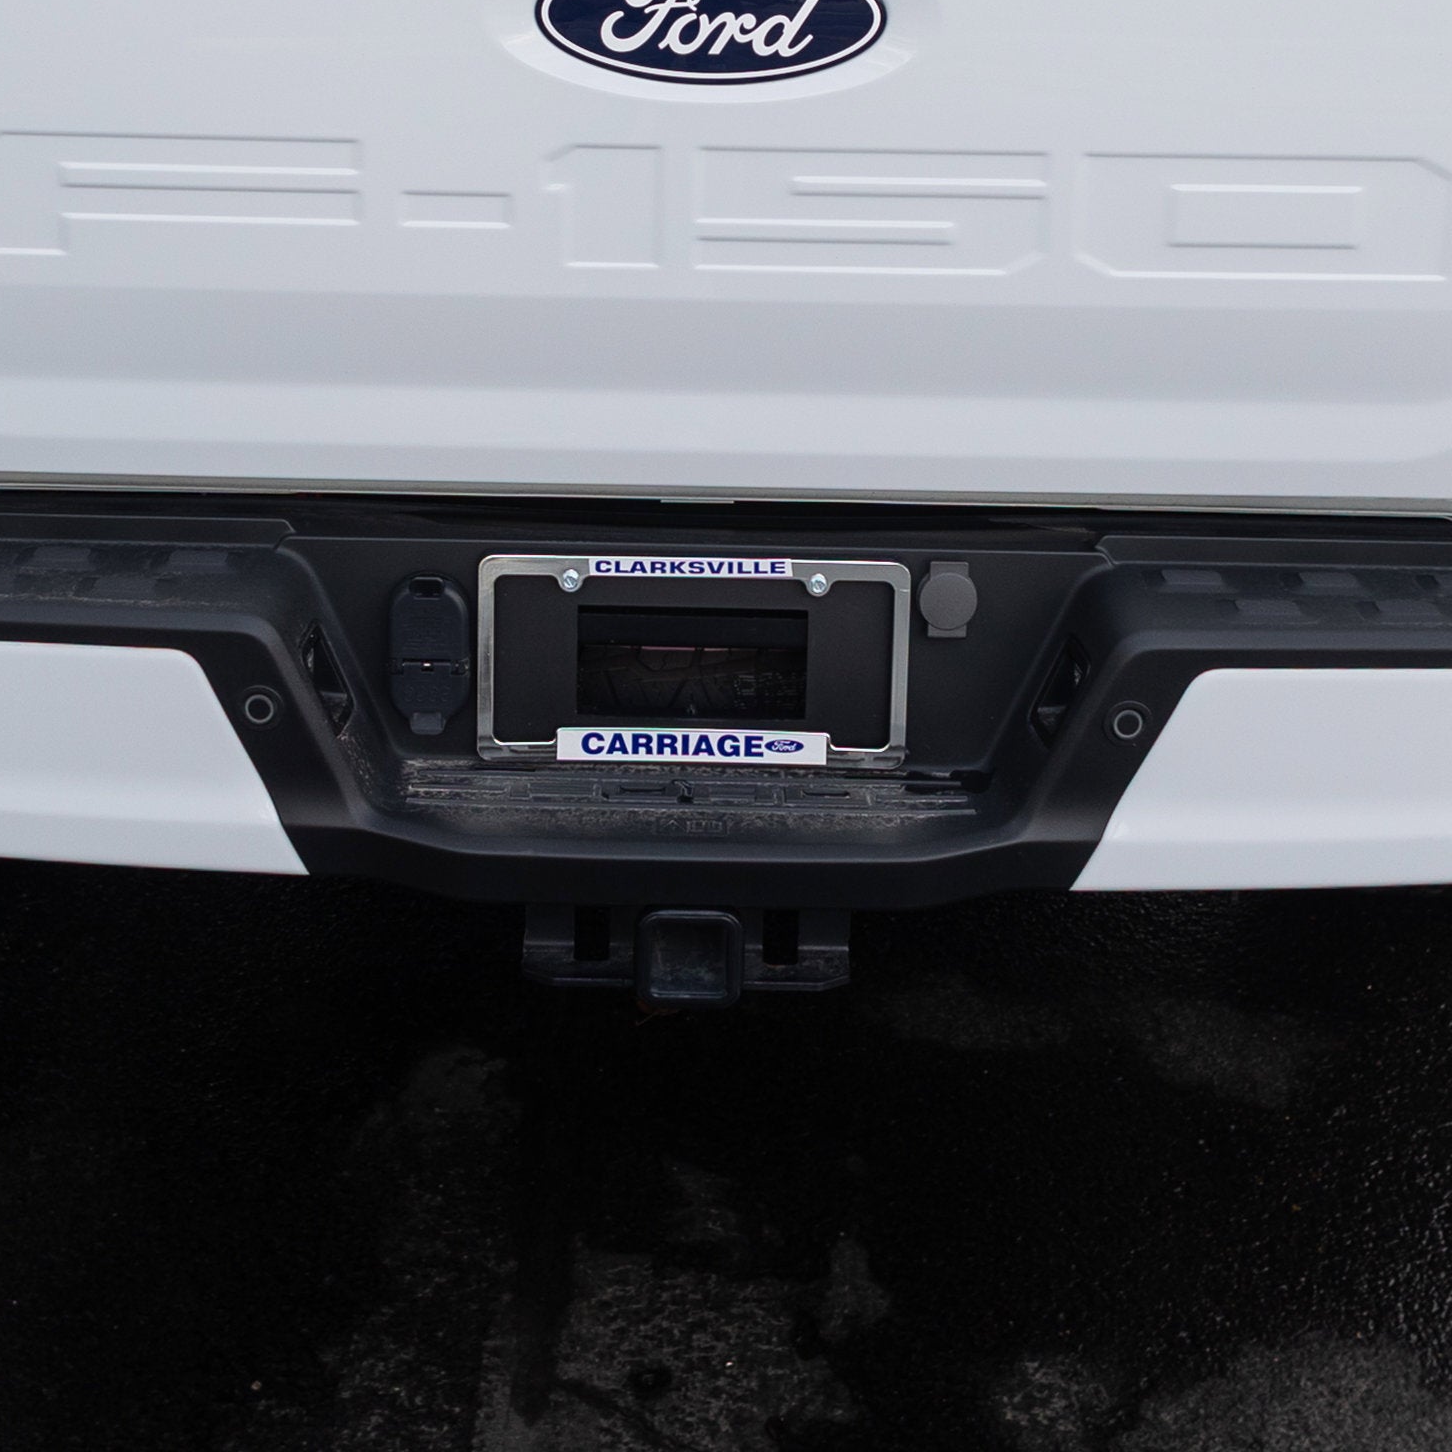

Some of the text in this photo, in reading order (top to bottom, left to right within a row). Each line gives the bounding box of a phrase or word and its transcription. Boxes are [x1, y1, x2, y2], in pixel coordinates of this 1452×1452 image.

[594, 560, 787, 575] CLARKSVILLE
[581, 732, 797, 758] CARRIAGE Ford
